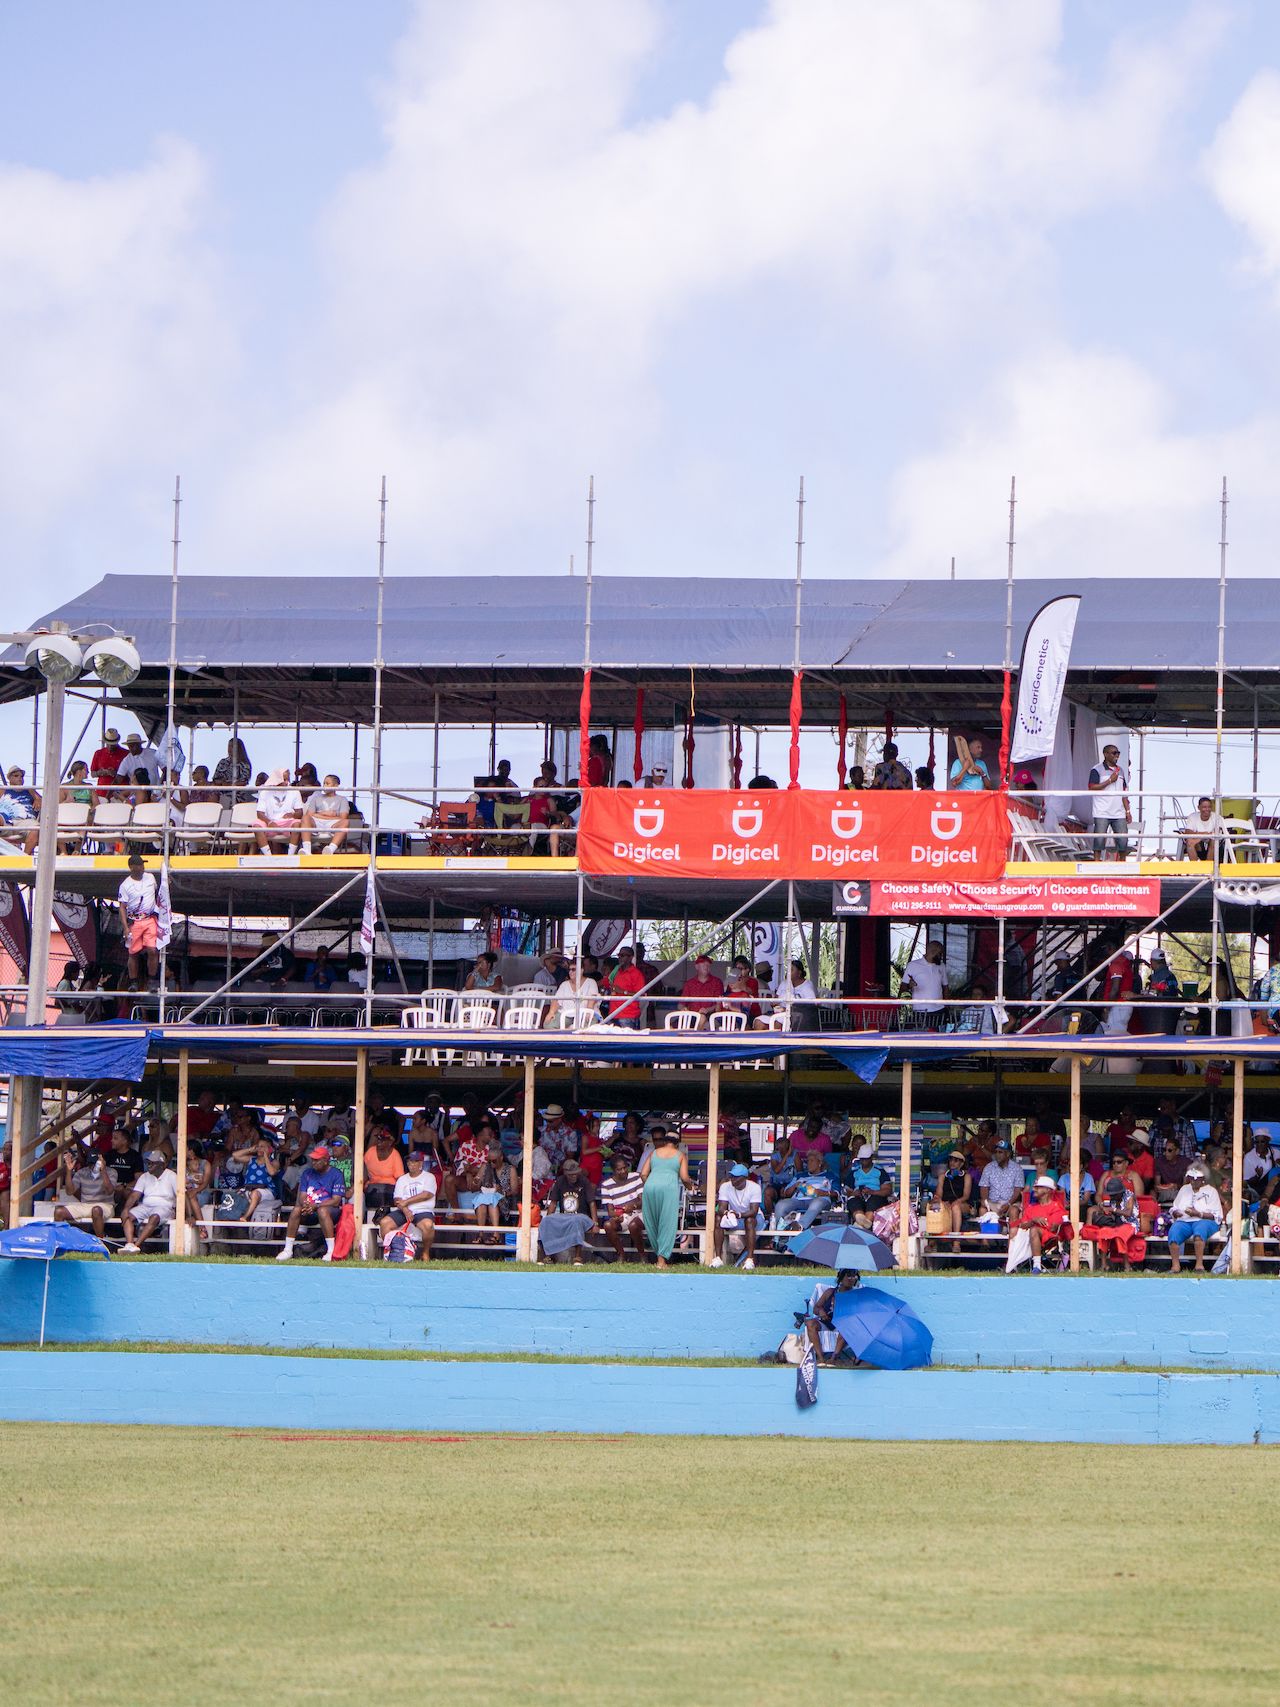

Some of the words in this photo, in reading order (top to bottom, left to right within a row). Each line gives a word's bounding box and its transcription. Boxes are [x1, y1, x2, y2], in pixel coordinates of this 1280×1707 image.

[1029, 638, 1050, 714] CariGenetics
[613, 842, 680, 864] Digicel
[711, 843, 780, 865] Digicel
[810, 844, 879, 867] Digicel
[911, 845, 978, 868] Digicel
[881, 882, 919, 894] Choose
[921, 883, 952, 896] Safety
[959, 883, 998, 895] Choose
[1000, 884, 1042, 896] Security
[1050, 883, 1088, 895] Choose
[1090, 883, 1150, 895] Guardsman
[891, 901, 910, 910] (441)
[911, 901, 942, 910] 296-9111
[948, 902, 1044, 912] www.guardsmangroup.com
[1066, 902, 1137, 912] guardsmanbermuda
[0, 919, 19, 953] DUCATION
